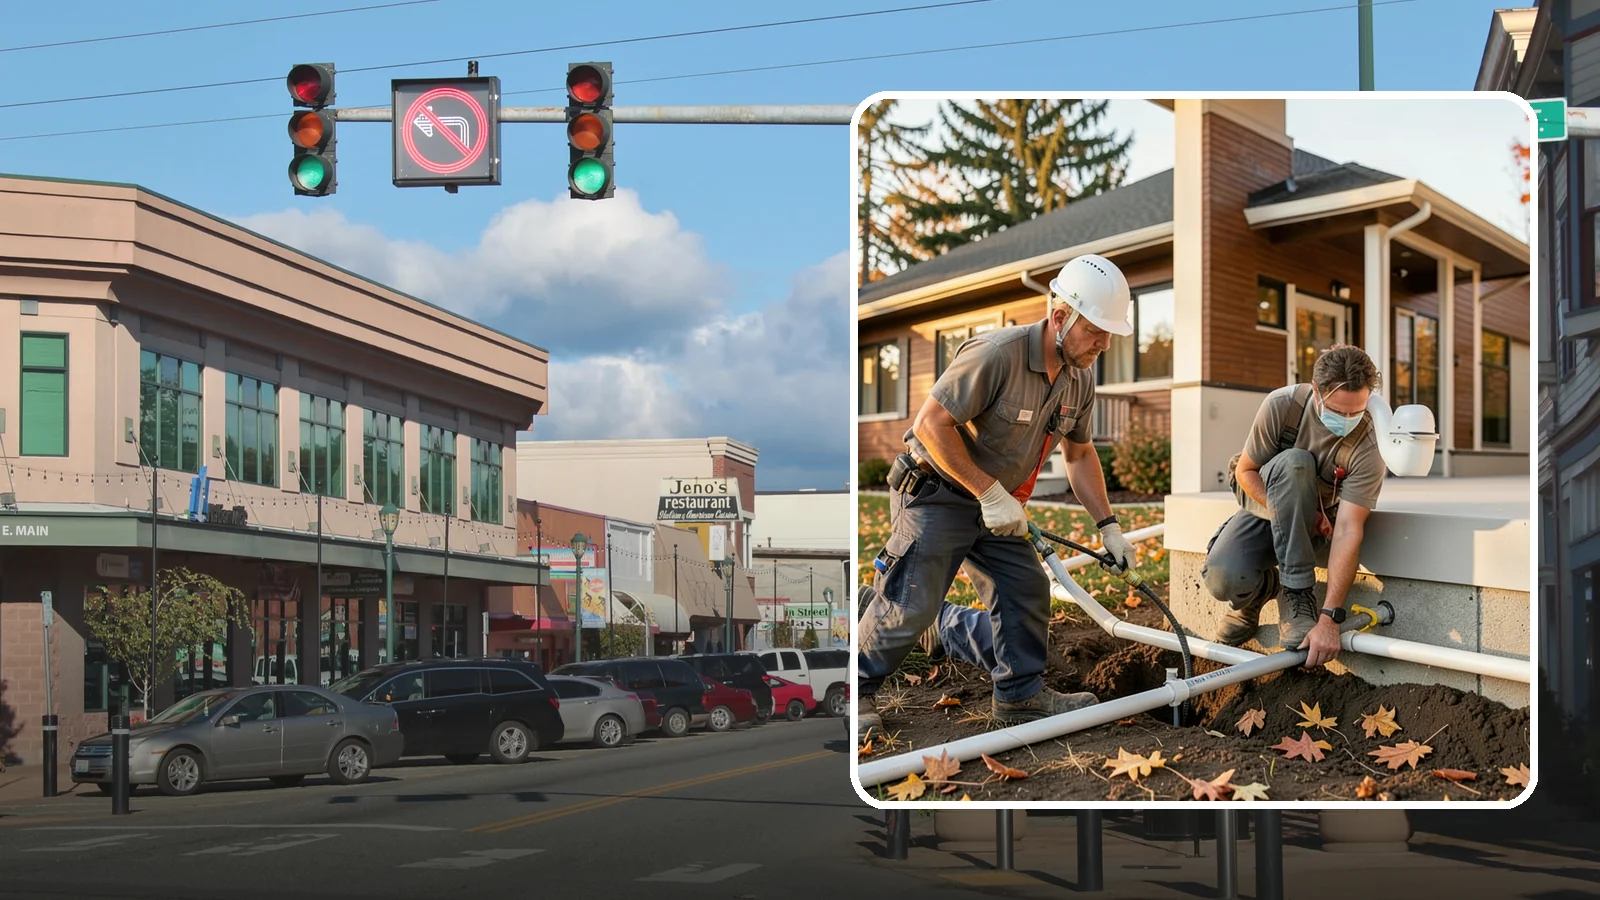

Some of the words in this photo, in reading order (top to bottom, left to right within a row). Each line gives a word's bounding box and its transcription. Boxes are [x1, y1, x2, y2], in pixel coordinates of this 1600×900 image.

[669, 480, 727, 495] Jeno's
[665, 496, 731, 509] restaurant
[658, 509, 681, 519] Italian
[686, 509, 714, 519] American
[715, 509, 737, 519] Cuisine
[2, 525, 13, 536] E.
[15, 525, 49, 536] MAIN
[797, 606, 829, 617] Street
